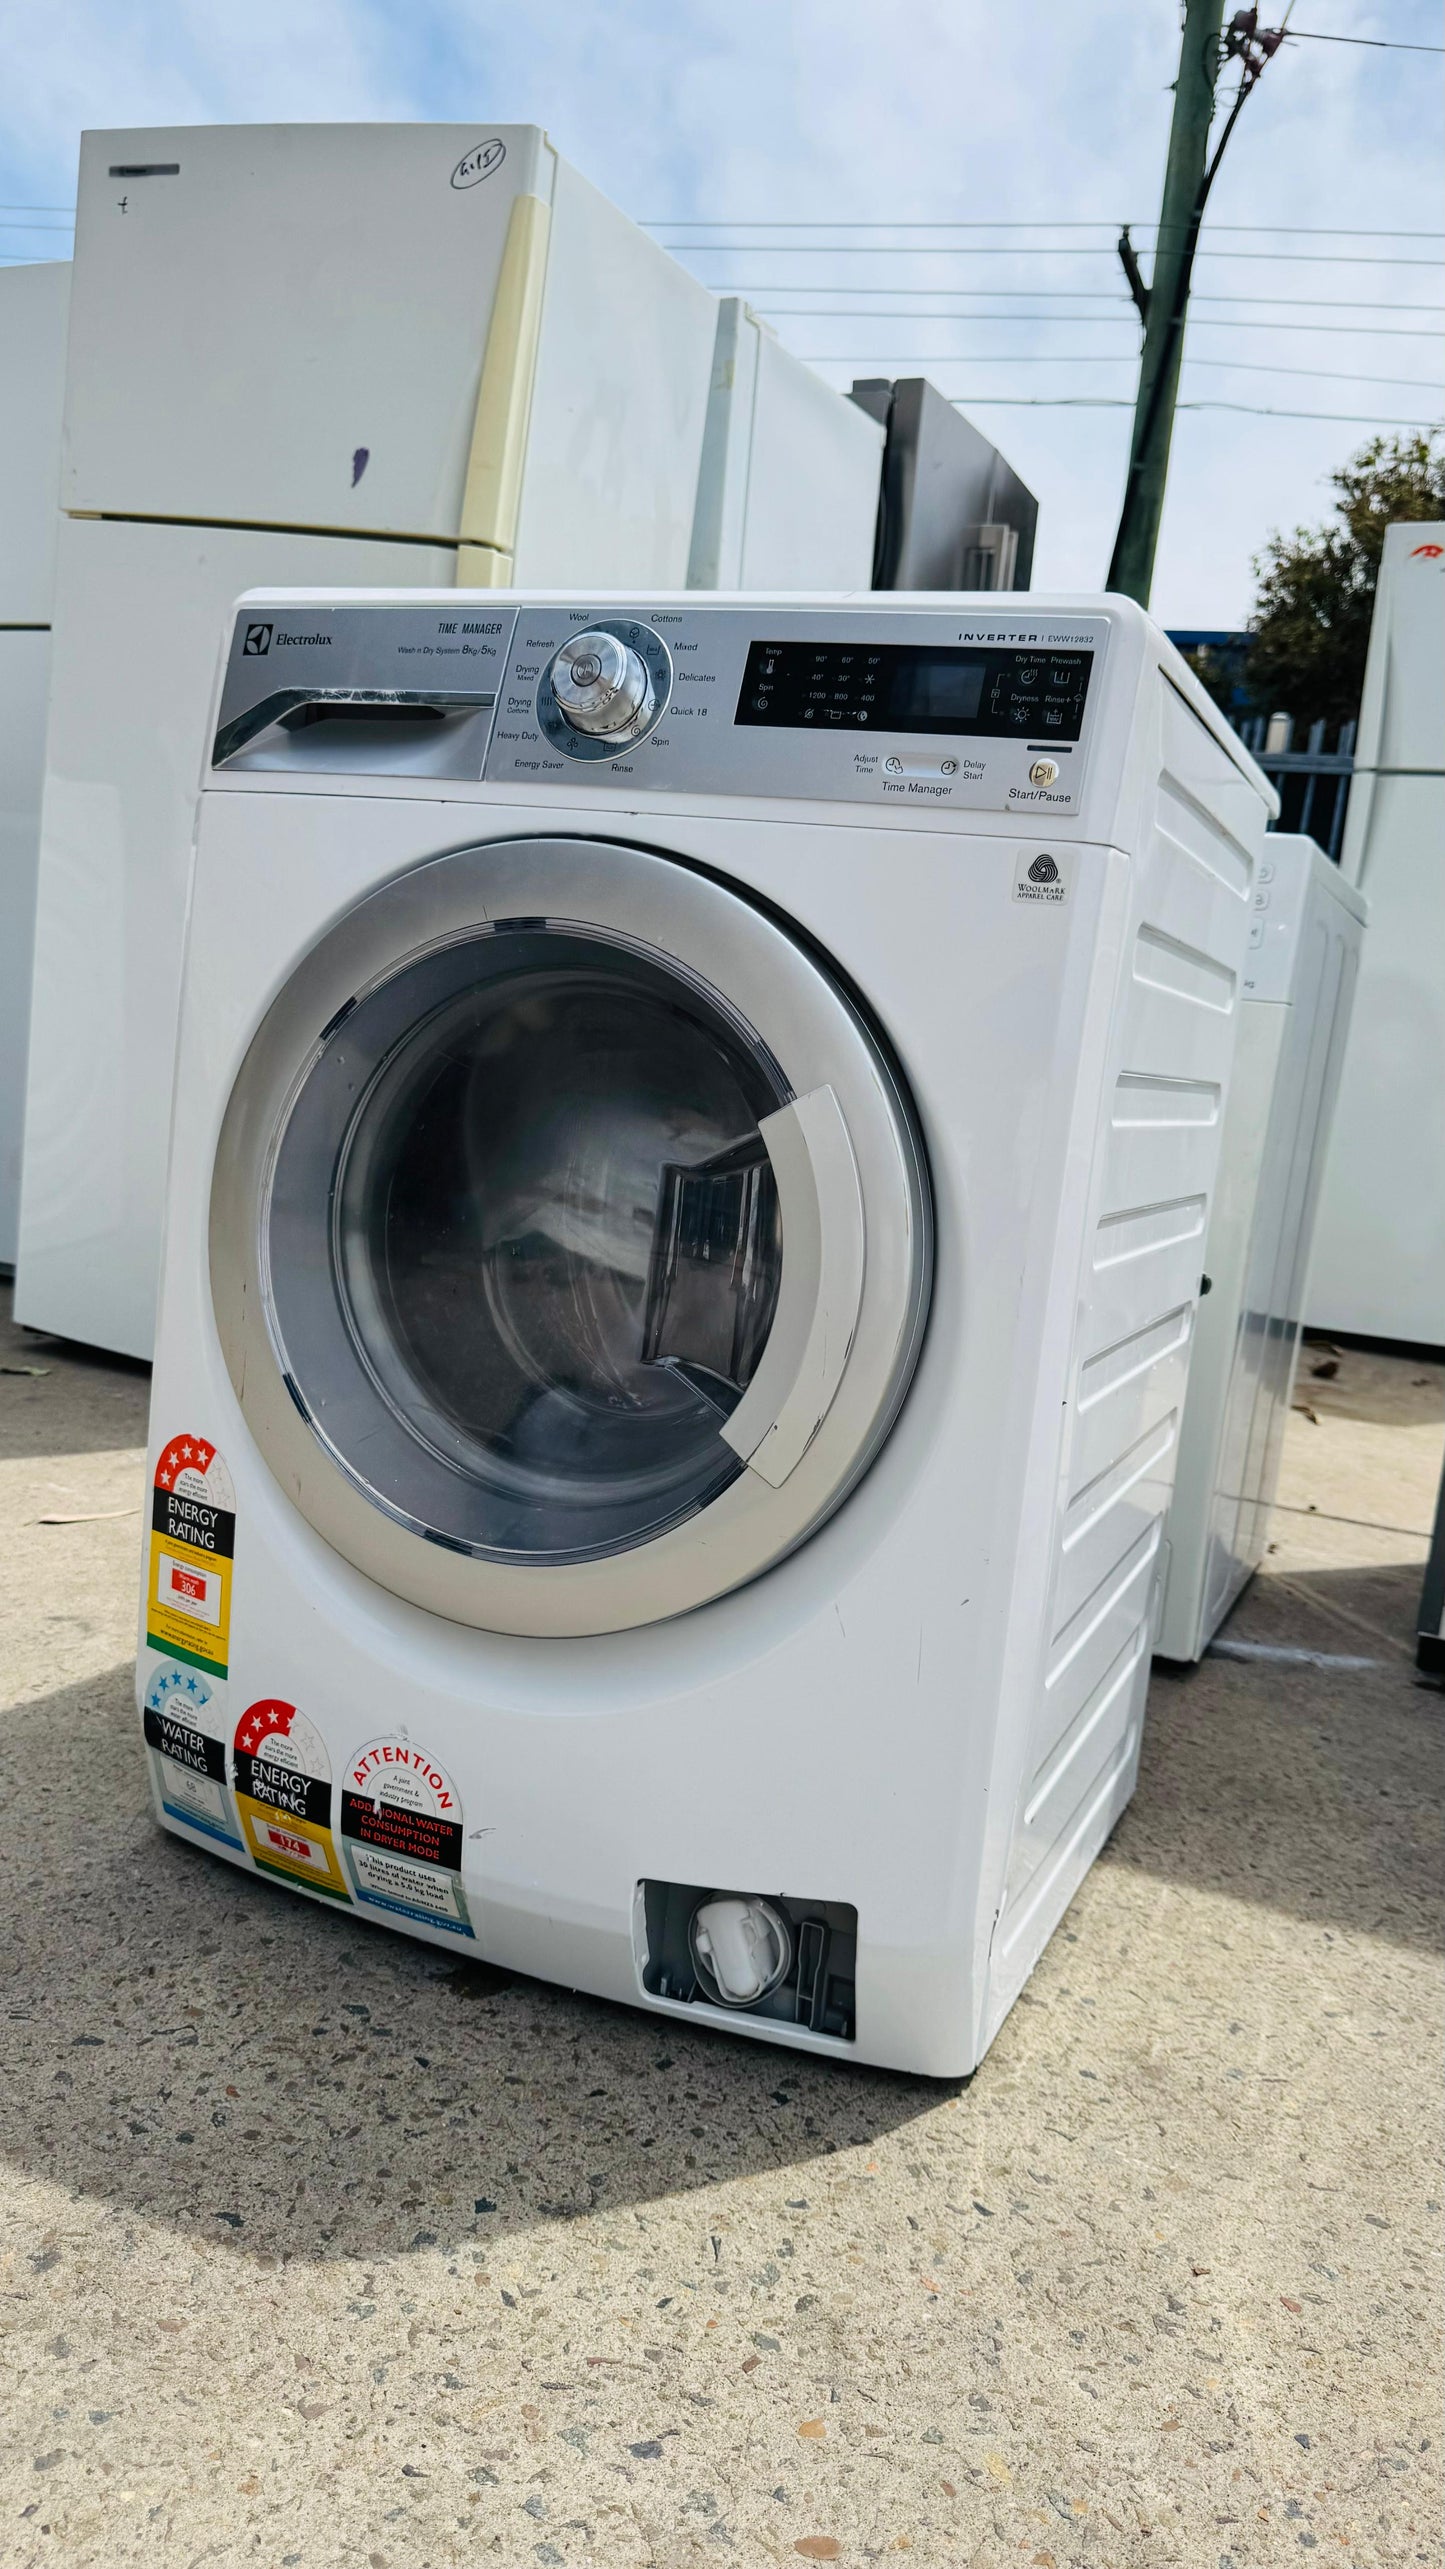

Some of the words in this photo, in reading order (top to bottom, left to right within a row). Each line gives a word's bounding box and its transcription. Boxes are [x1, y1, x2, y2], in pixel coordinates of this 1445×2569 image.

[569, 613, 590, 621] Wool
[651, 614, 683, 623] Cottons
[438, 623, 458, 634] TIME
[461, 623, 503, 635] MANAGER
[276, 633, 332, 645] Electrolux
[958, 633, 1038, 642] INVERTER
[526, 639, 555, 648] Refresh
[673, 642, 698, 651] Mixed
[397, 646, 416, 654] Wash
[423, 646, 434, 656] Dry
[435, 646, 461, 656] System
[765, 647, 782, 656] Temp
[1015, 655, 1028, 664] Dry
[1030, 656, 1046, 664] Time
[1050, 656, 1082, 665] Prewash
[515, 664, 540, 675] Drying
[678, 672, 716, 682] Delicates
[758, 683, 774, 692] Spin
[507, 697, 532, 707] Drying
[808, 691, 827, 699] 1200
[860, 694, 875, 702] 400
[1010, 693, 1039, 703] Dryness
[670, 706, 694, 716] Quick
[697, 708, 708, 717] 18
[496, 730, 520, 741] Heavy
[521, 731, 539, 741] Duty
[650, 736, 670, 747] Spin
[514, 759, 541, 770] Energy
[542, 760, 564, 769] Saver
[853, 754, 878, 764] Adjust
[963, 759, 986, 770] Delay
[611, 763, 634, 773] Rinse
[855, 765, 874, 773] Time
[963, 771, 983, 780] Start
[882, 781, 905, 792] Time
[907, 783, 952, 797] Manager
[1008, 787, 1072, 803] Start/Pause
[1017, 892, 1044, 900] APPAREL
[168, 1496, 219, 1528] ENERGY
[168, 1517, 215, 1549] RATING
[181, 1580, 197, 1596] 306
[162, 1718, 205, 1754] WATER
[161, 1738, 208, 1772] RATING
[251, 1759, 311, 1796] ENERGY
[353, 1746, 453, 1808] ATTENTION
[398, 1776, 411, 1785] joint
[383, 1782, 414, 1796] government
[252, 1780, 306, 1815] RATING
[400, 1796, 424, 1808] program
[349, 1798, 415, 1826] ADDIONAL
[416, 1818, 453, 1836] WATER
[361, 1815, 440, 1846] CONSUMPTION
[360, 1827, 371, 1838] IN
[373, 1832, 405, 1849] DRYER
[408, 1842, 440, 1859] MODE
[385, 1861, 417, 1877] product
[418, 1873, 437, 1883] uses
[369, 1864, 390, 1875] litres
[391, 1871, 400, 1879] of
[401, 1874, 424, 1886] water
[426, 1883, 449, 1895] when
[367, 1871, 393, 1886] drying
[414, 1886, 425, 1896] kg
[425, 1889, 444, 1901] load
